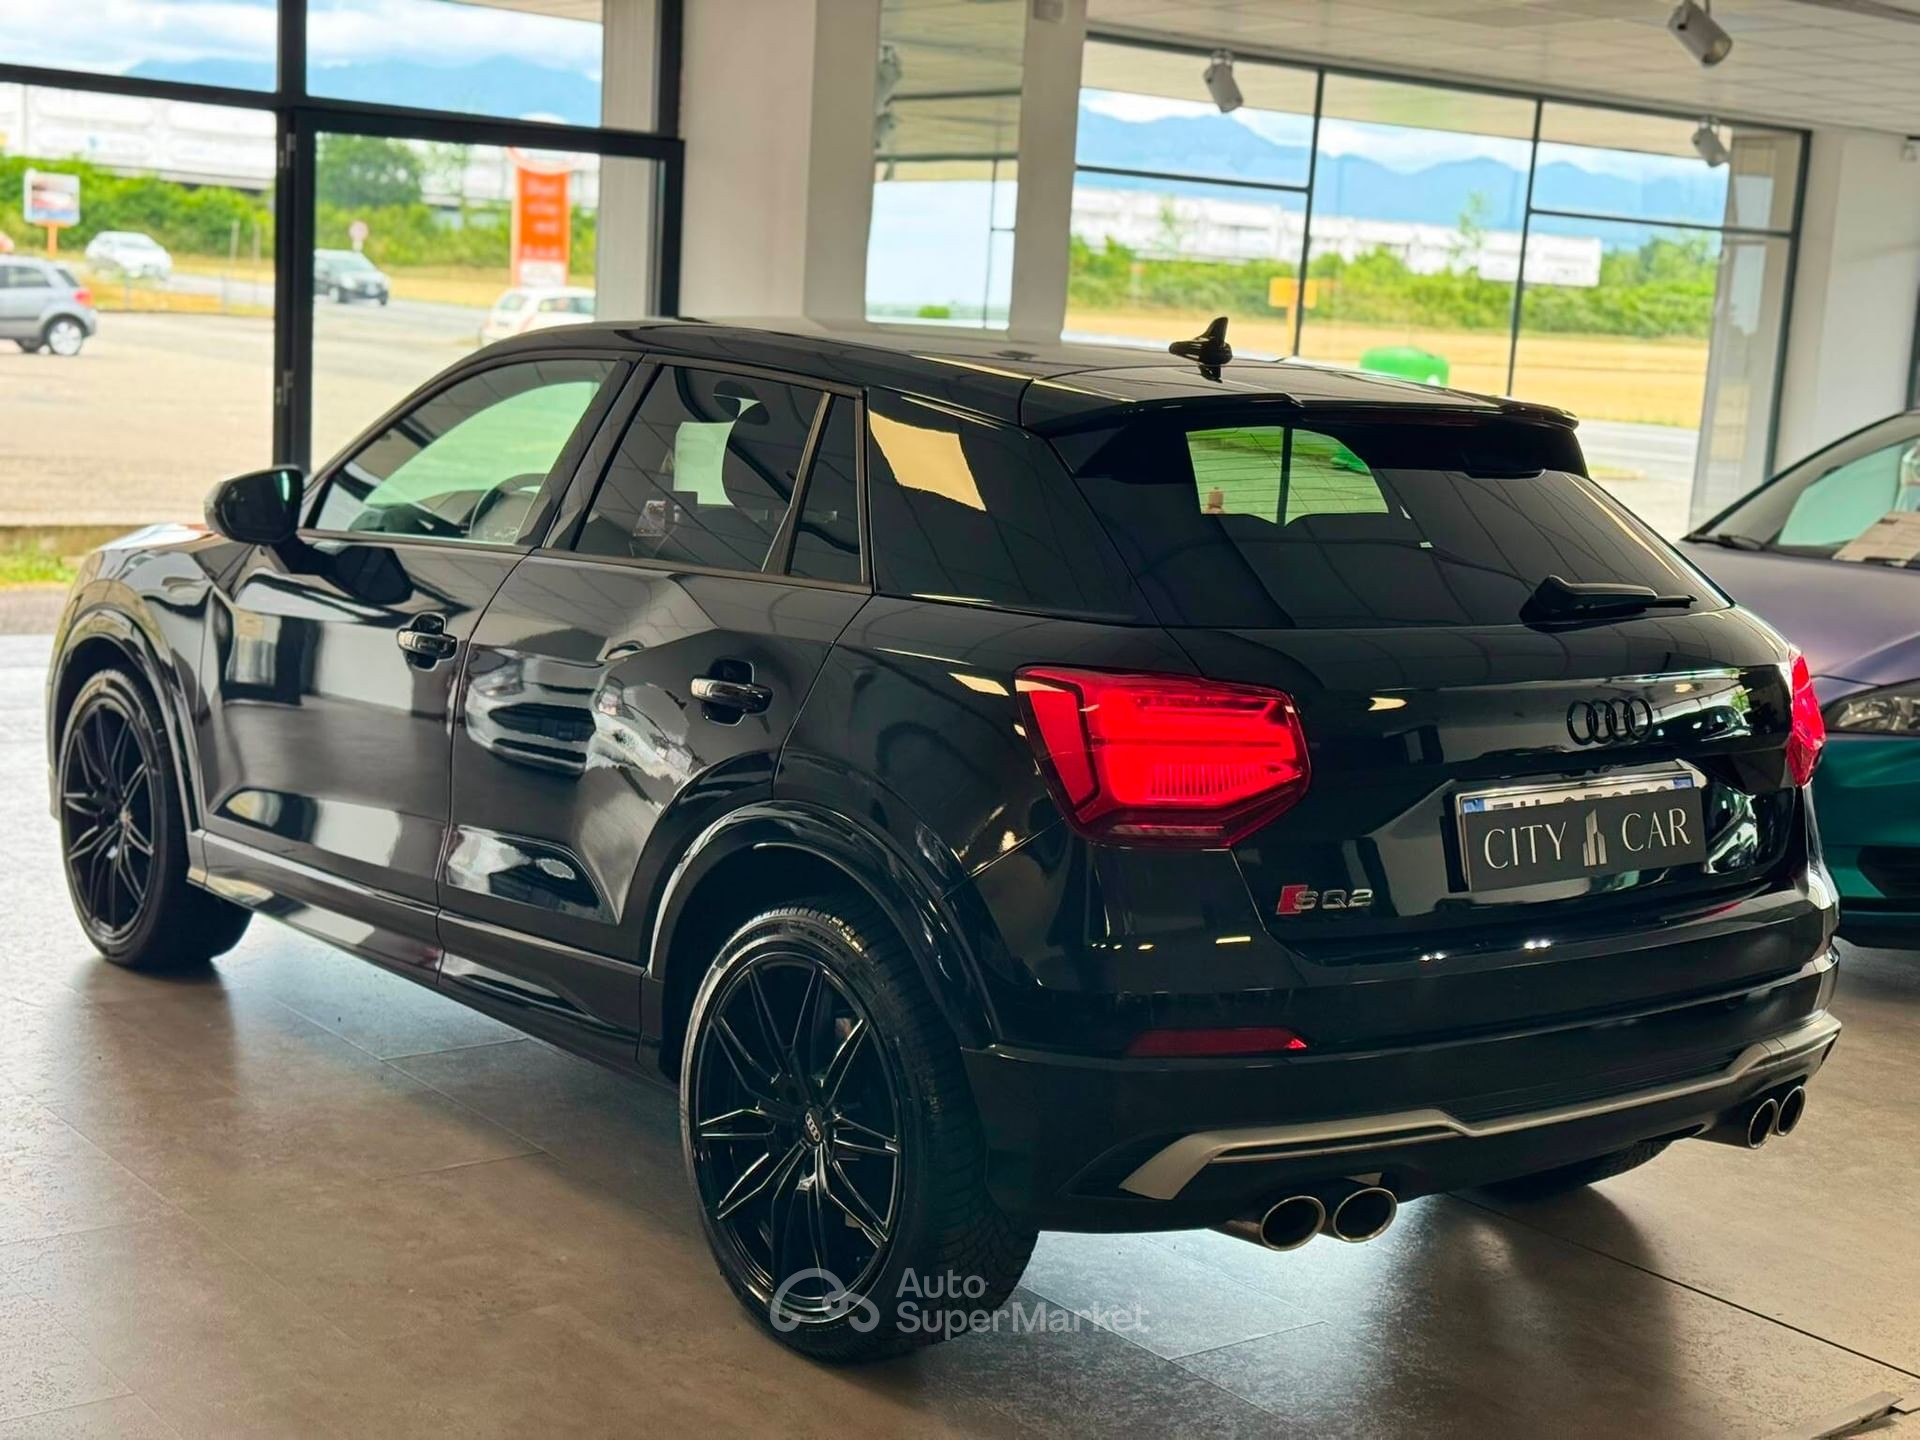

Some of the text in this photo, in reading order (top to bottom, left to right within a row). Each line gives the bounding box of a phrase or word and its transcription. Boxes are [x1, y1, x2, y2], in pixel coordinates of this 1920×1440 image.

[1484, 807, 1691, 869] CITY CAR
[1293, 888, 1374, 912] SQ2
